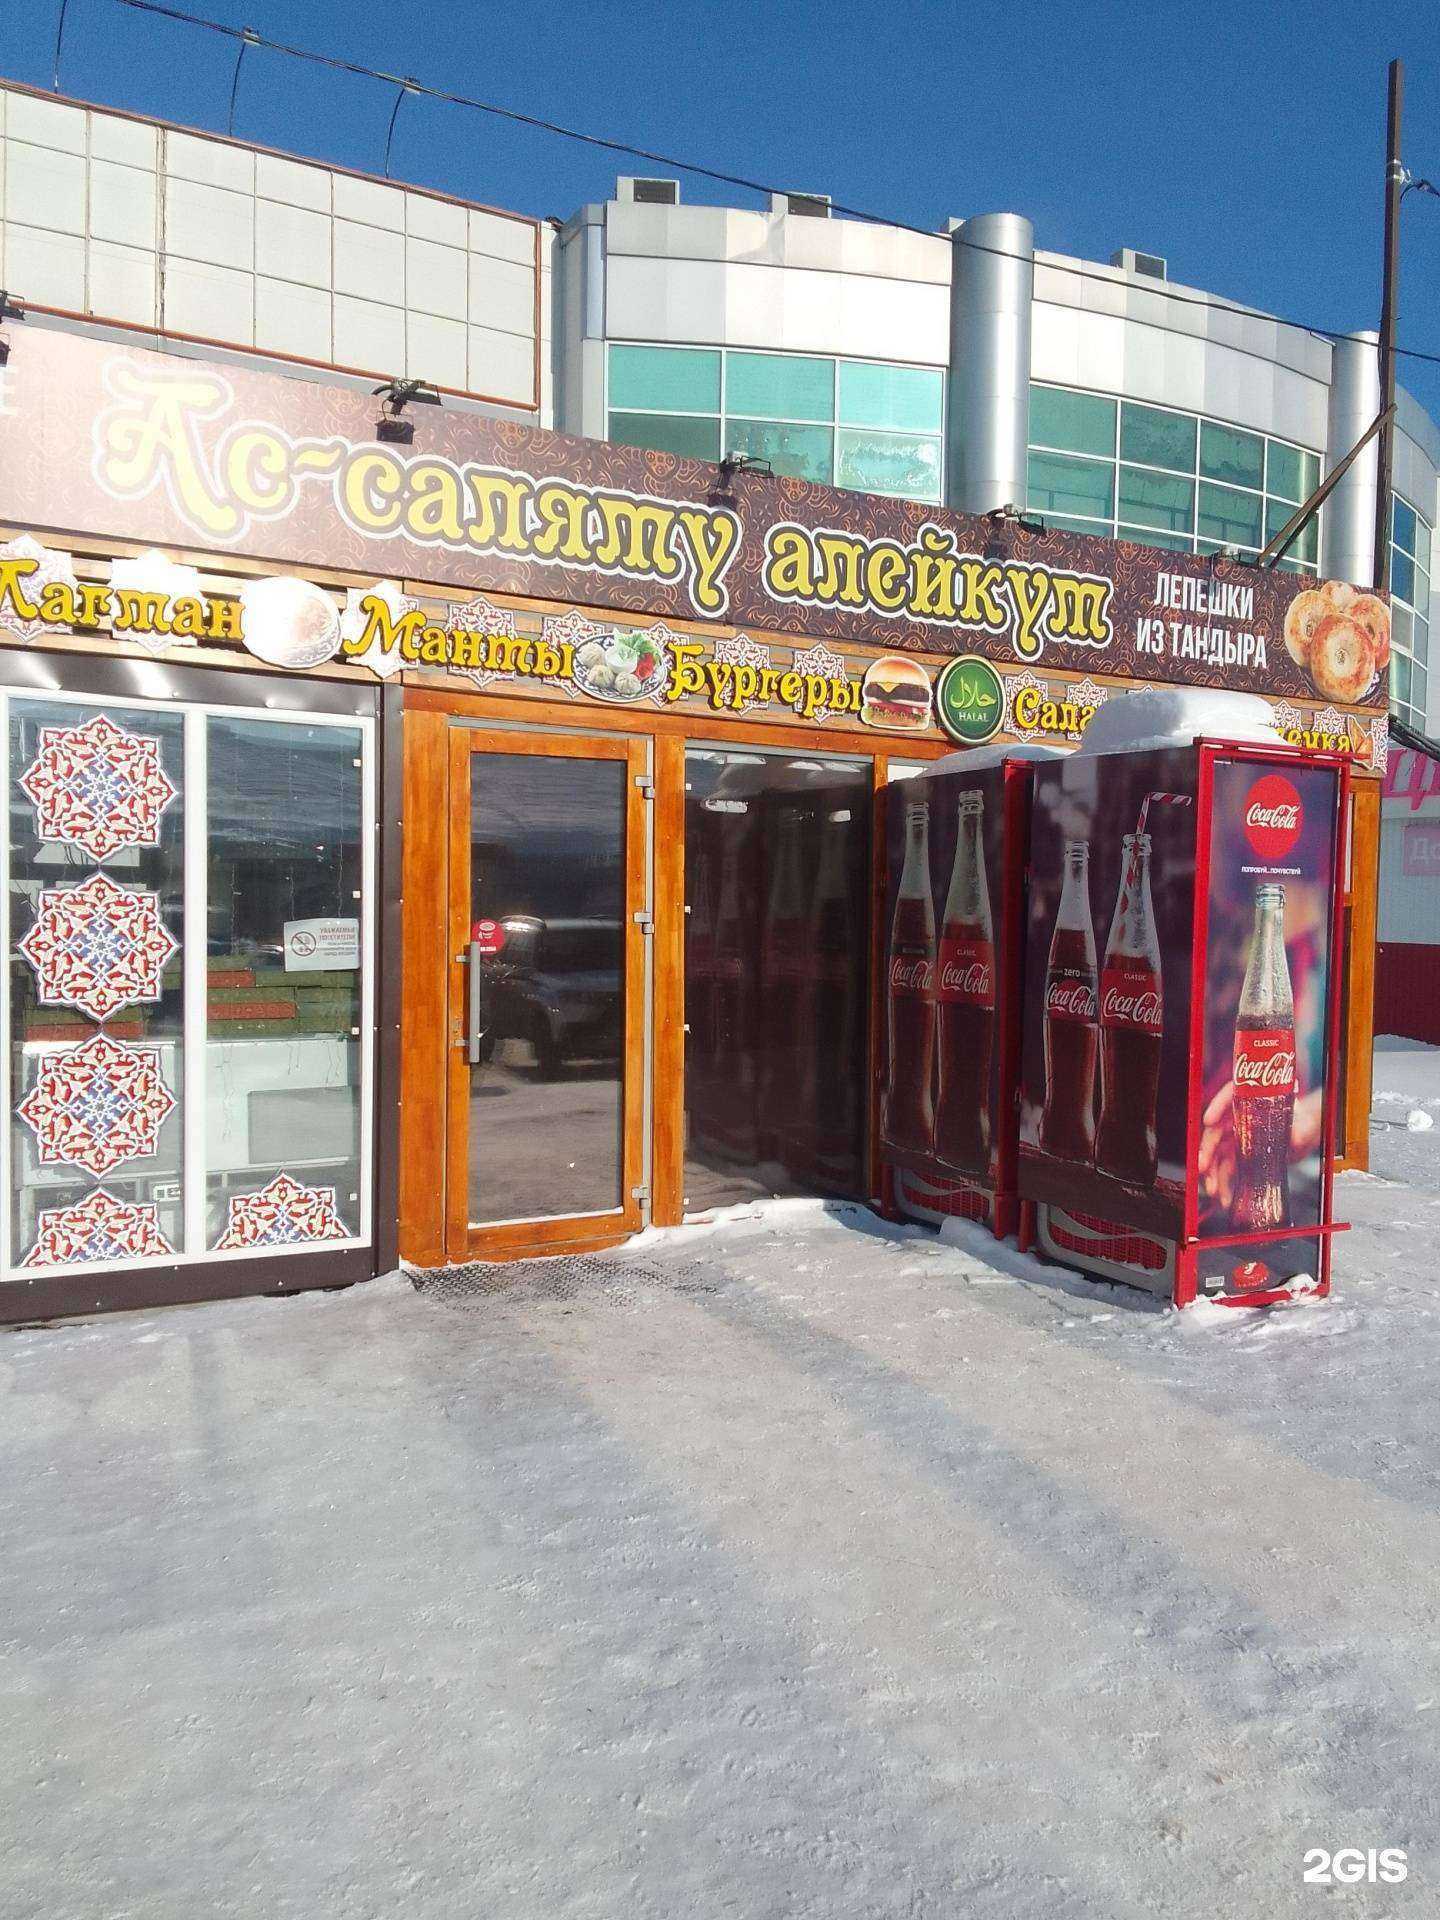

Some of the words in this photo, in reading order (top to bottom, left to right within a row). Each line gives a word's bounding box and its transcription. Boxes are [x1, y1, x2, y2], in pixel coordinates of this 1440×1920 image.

[1153, 572, 1254, 620] ЛЕПЕШКИ
[341, 595, 576, 677] Манты
[1136, 617, 1165, 654] ИЗ
[1169, 622, 1268, 669] ТАНДЫРА
[666, 643, 862, 718] Бургеры
[950, 675, 997, 709] حلال
[958, 711, 989, 722] HALAL
[1015, 687, 1097, 733] Сала
[1246, 802, 1301, 829] Coca-Cola
[891, 958, 934, 989] Coca-Cola
[941, 961, 991, 994] Coca-Cola
[1046, 982, 1095, 1017] Coca-Cola
[1103, 987, 1162, 1025] Coca-Cola
[1253, 1039, 1280, 1047] CLASSIC
[1234, 1051, 1296, 1087] Coca-Cola
